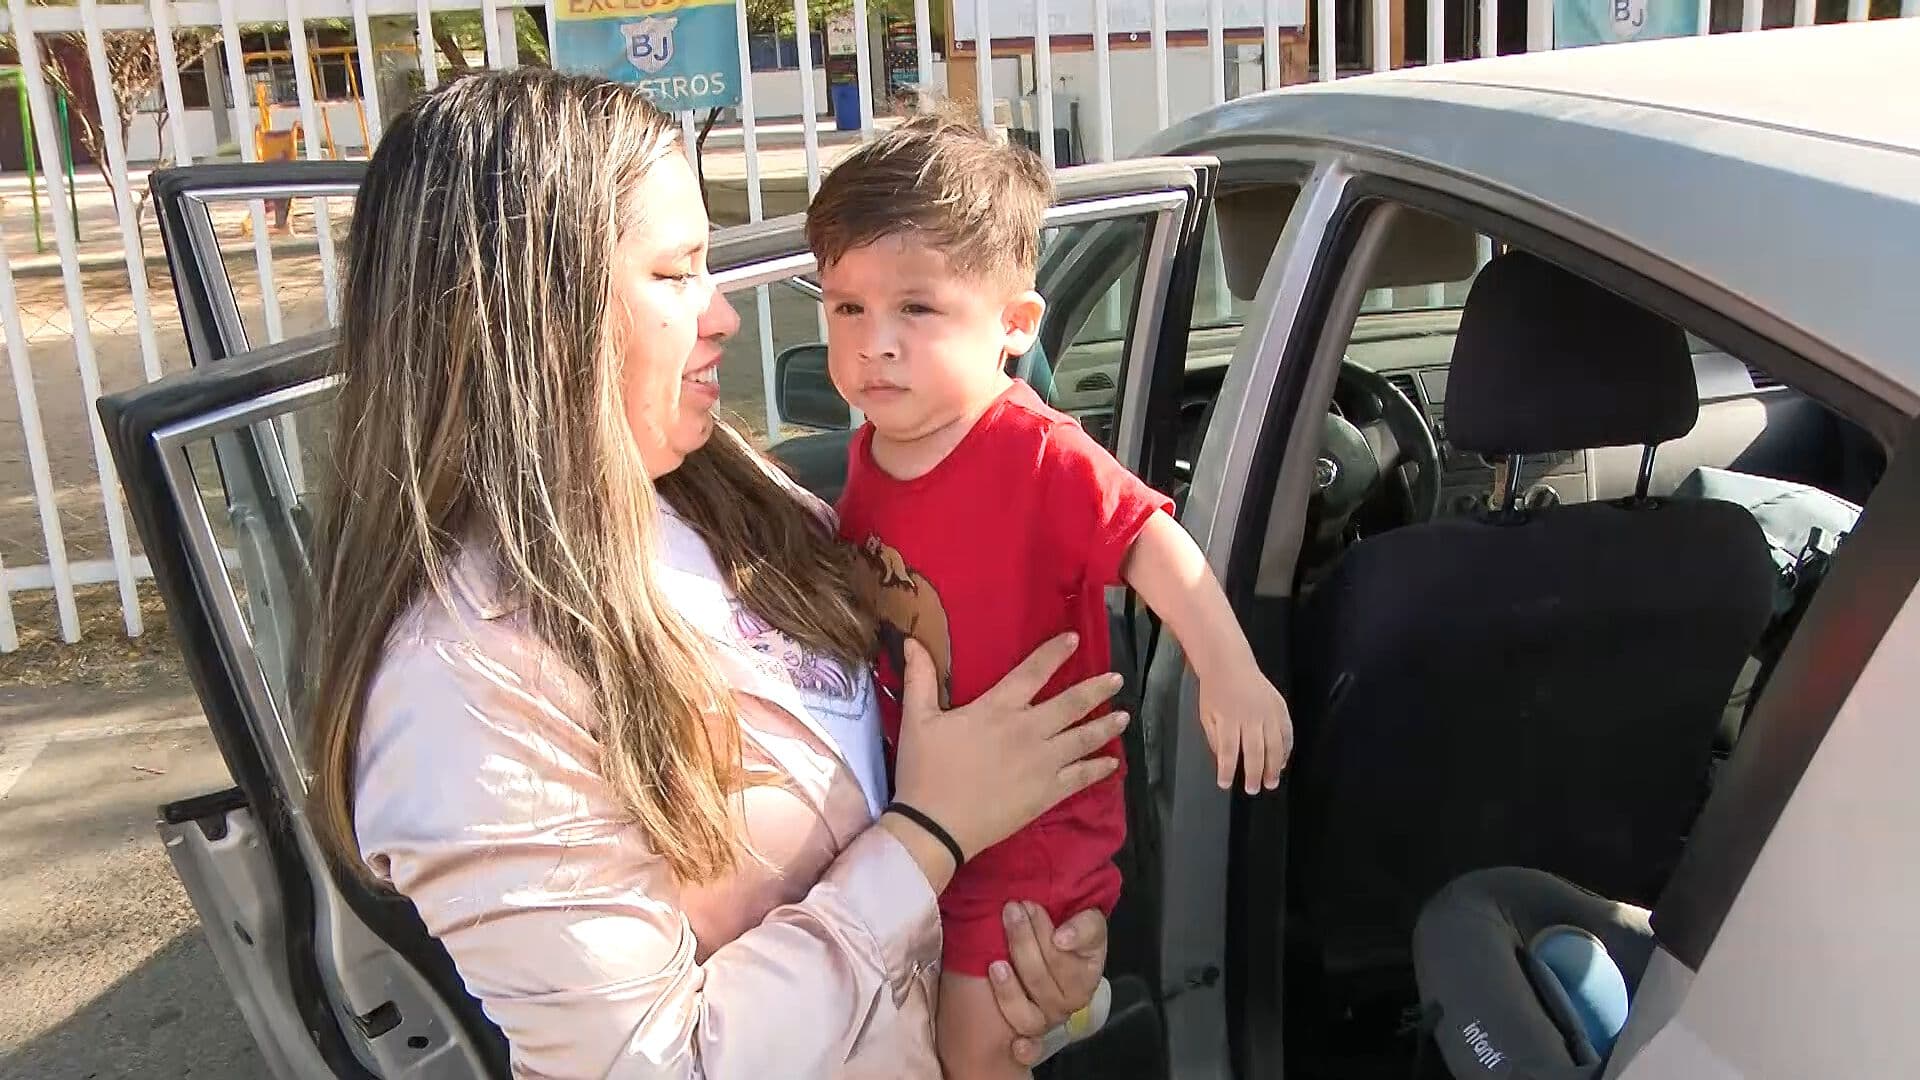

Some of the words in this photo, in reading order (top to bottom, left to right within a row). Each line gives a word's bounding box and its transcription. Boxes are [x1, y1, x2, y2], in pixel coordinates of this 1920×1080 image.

[632, 34, 669, 61] BJ
[638, 72, 726, 99] STROS
[1463, 1020, 1505, 1069] infanti
